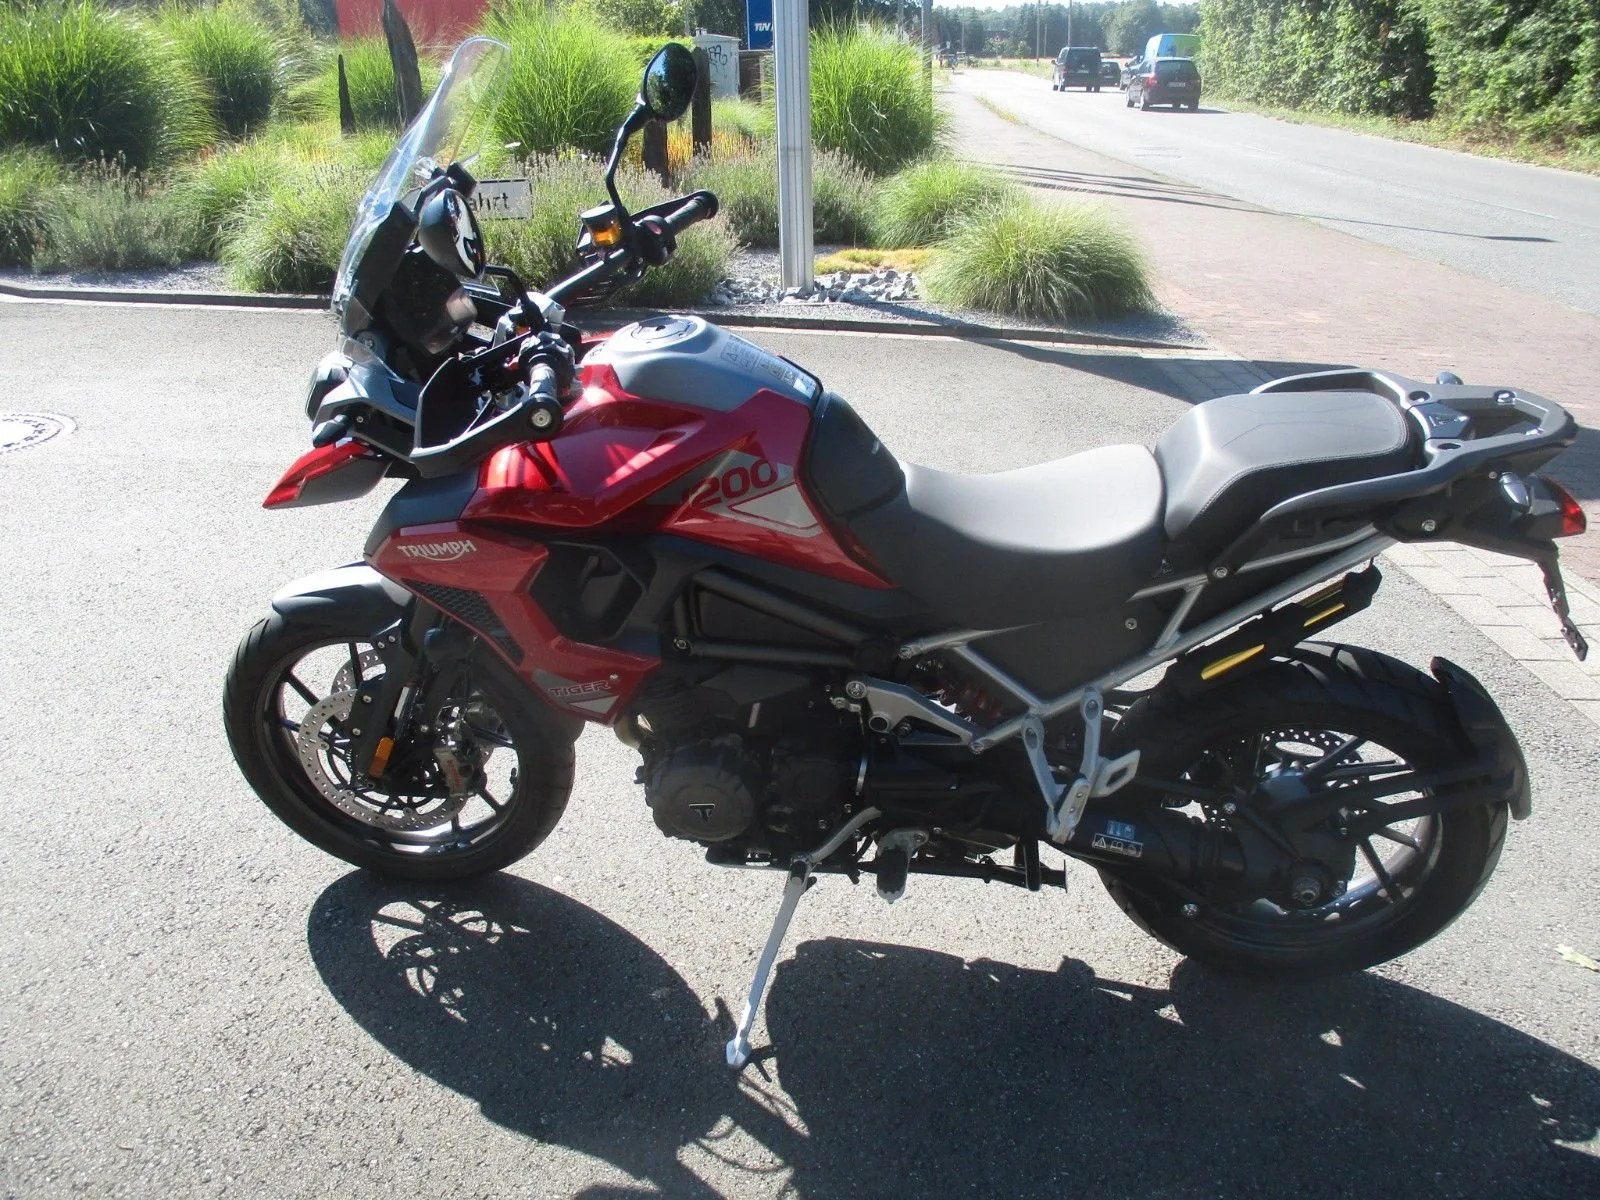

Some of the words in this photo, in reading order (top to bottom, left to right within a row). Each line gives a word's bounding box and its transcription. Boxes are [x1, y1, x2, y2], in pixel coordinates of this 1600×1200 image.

[754, 22, 772, 32] TÜV
[469, 192, 510, 211] ahrt
[397, 539, 477, 561] TRIUMPH
[548, 680, 612, 697] TIGER
